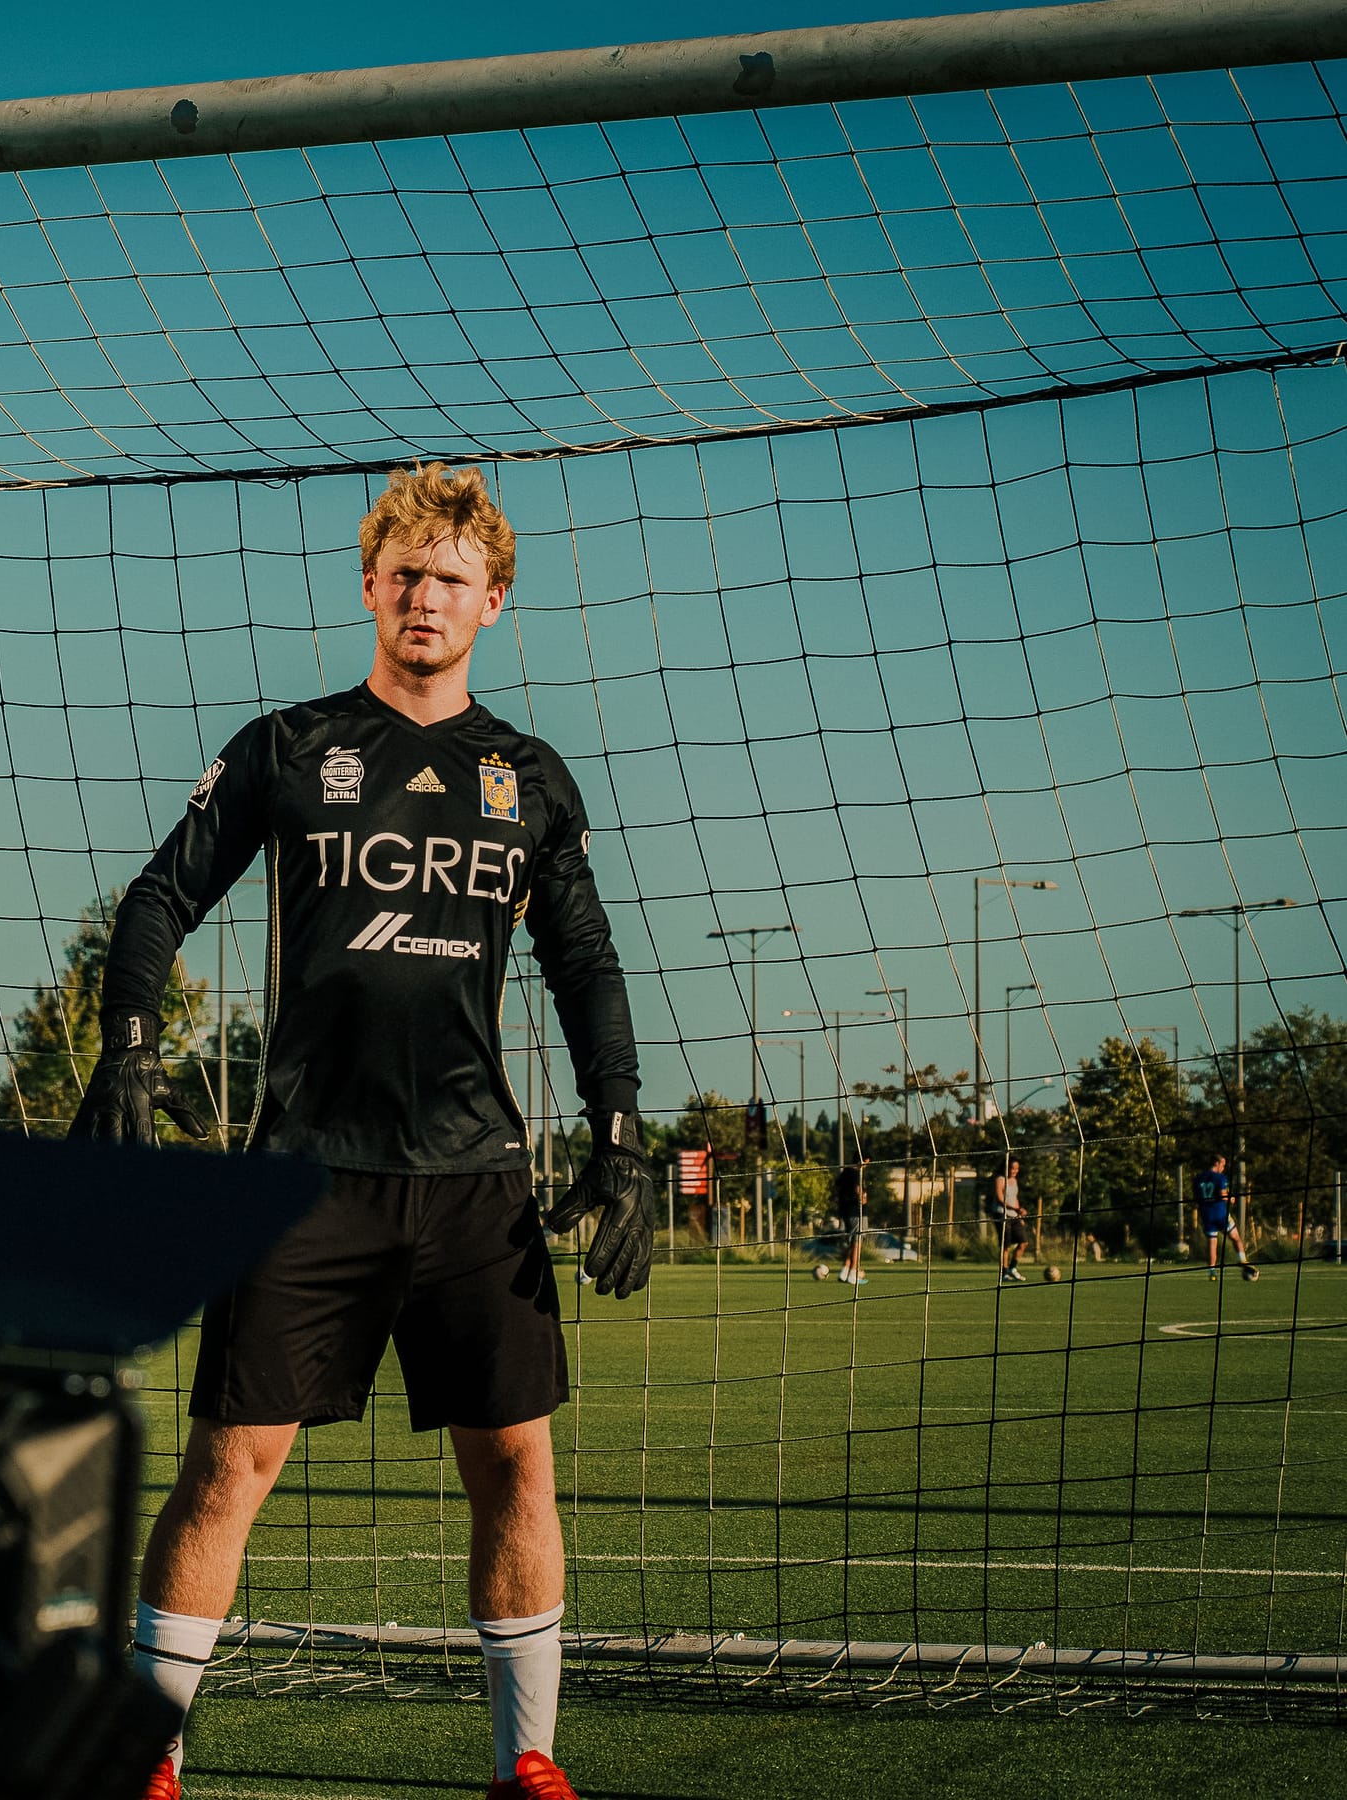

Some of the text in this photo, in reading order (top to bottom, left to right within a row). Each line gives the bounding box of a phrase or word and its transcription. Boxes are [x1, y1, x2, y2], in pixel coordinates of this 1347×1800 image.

[323, 767, 362, 777] MONTERREY
[482, 768, 514, 780] TIGRES
[406, 783, 446, 793] adidas
[327, 791, 356, 799] EXTRA
[490, 808, 510, 817] UANL
[307, 832, 525, 903] TIGRES
[394, 936, 481, 960] CEMEX
